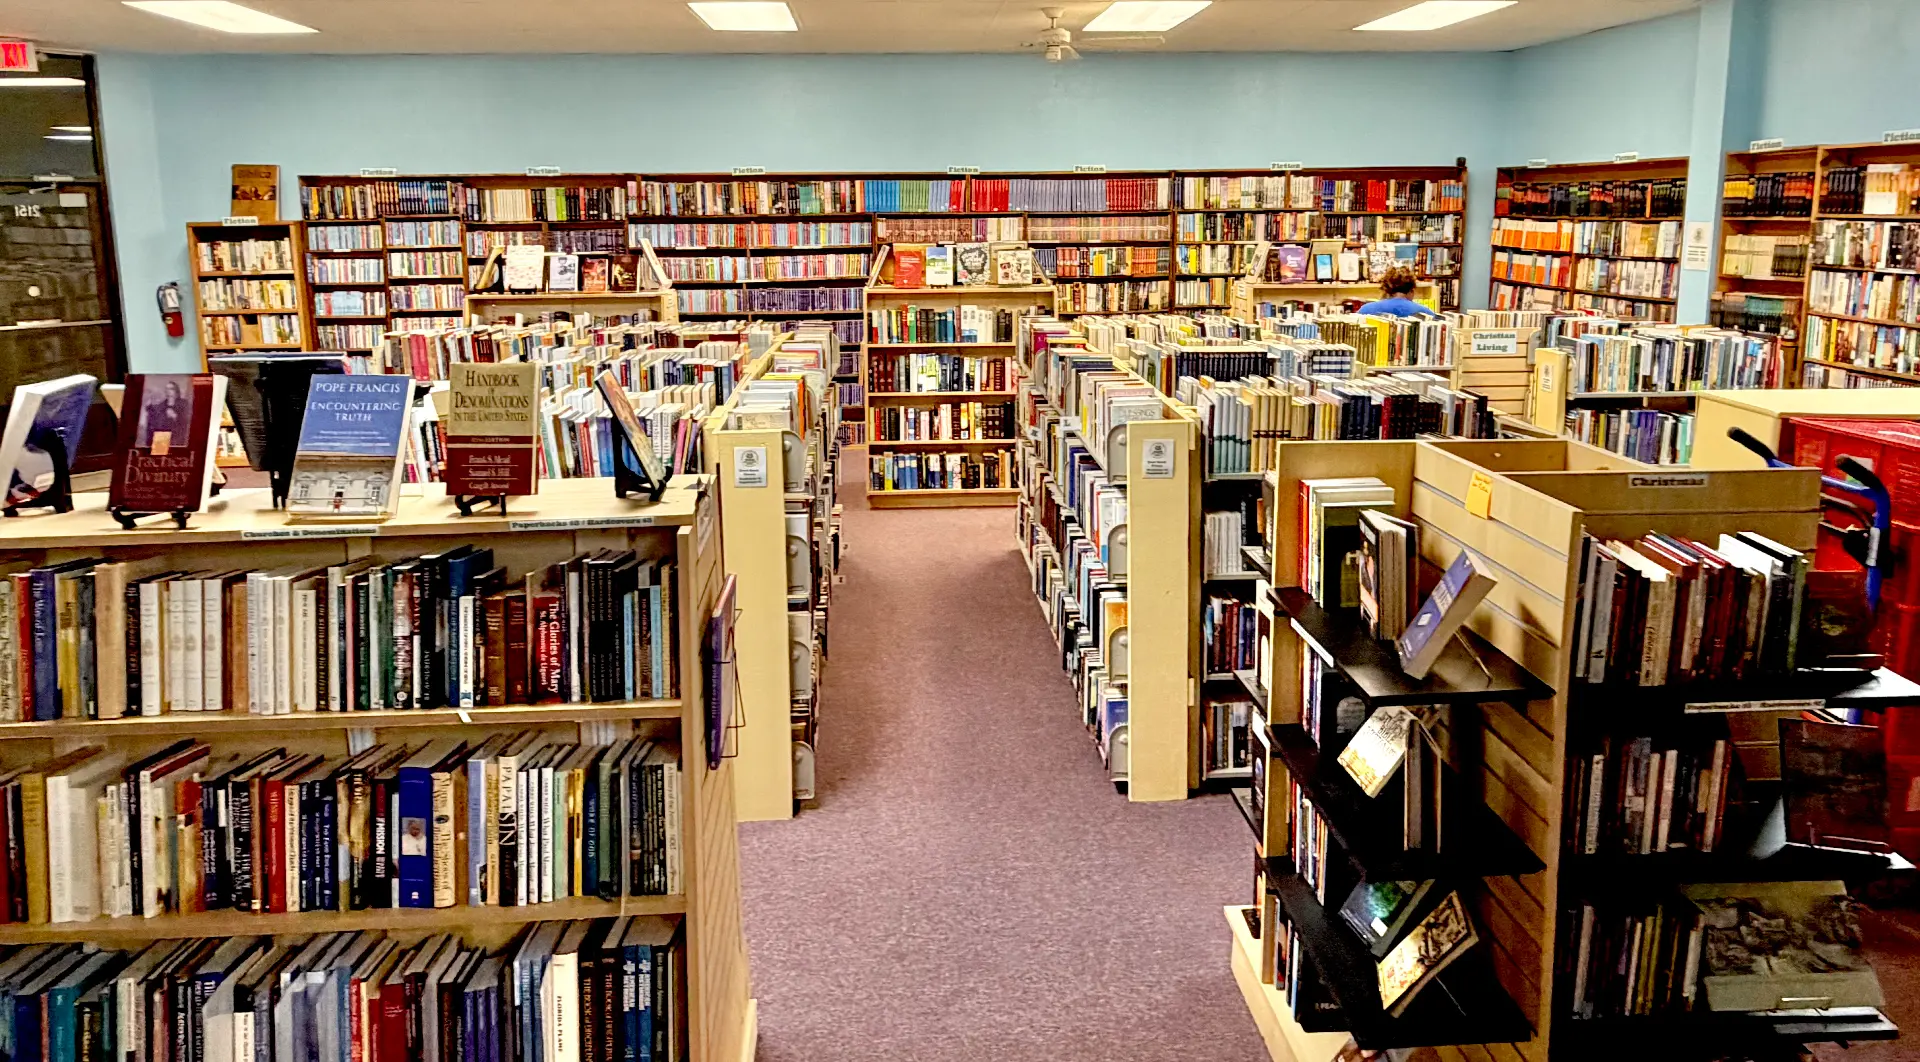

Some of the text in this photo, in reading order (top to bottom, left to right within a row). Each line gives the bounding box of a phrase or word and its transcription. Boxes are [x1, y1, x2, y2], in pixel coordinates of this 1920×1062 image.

[1752, 141, 1782, 151] Fiction
[224, 217, 257, 225] Fiction
[1476, 343, 1508, 352] Living
[315, 382, 401, 393] POPE FRANCIS
[311, 401, 401, 411] ENCOUNTERING
[335, 412, 372, 421] TRUTH
[127, 448, 195, 468] Practical
[124, 463, 191, 488] Divinity
[1632, 477, 1704, 487] Christmas
[512, 520, 568, 530] Paperbacks
[587, 517, 640, 527] Hardcovers
[540, 611, 548, 620] St.
[538, 621, 548, 653] Alphonsus
[548, 601, 561, 694] The Glories of Mary
[540, 654, 548, 662] de
[588, 798, 596, 824] WORK
[498, 812, 517, 846] SIN
[543, 817, 551, 836] What
[375, 822, 386, 855] MISSION
[583, 977, 592, 994] THE
[605, 973, 613, 989] THE
[583, 994, 592, 1016] BOOK
